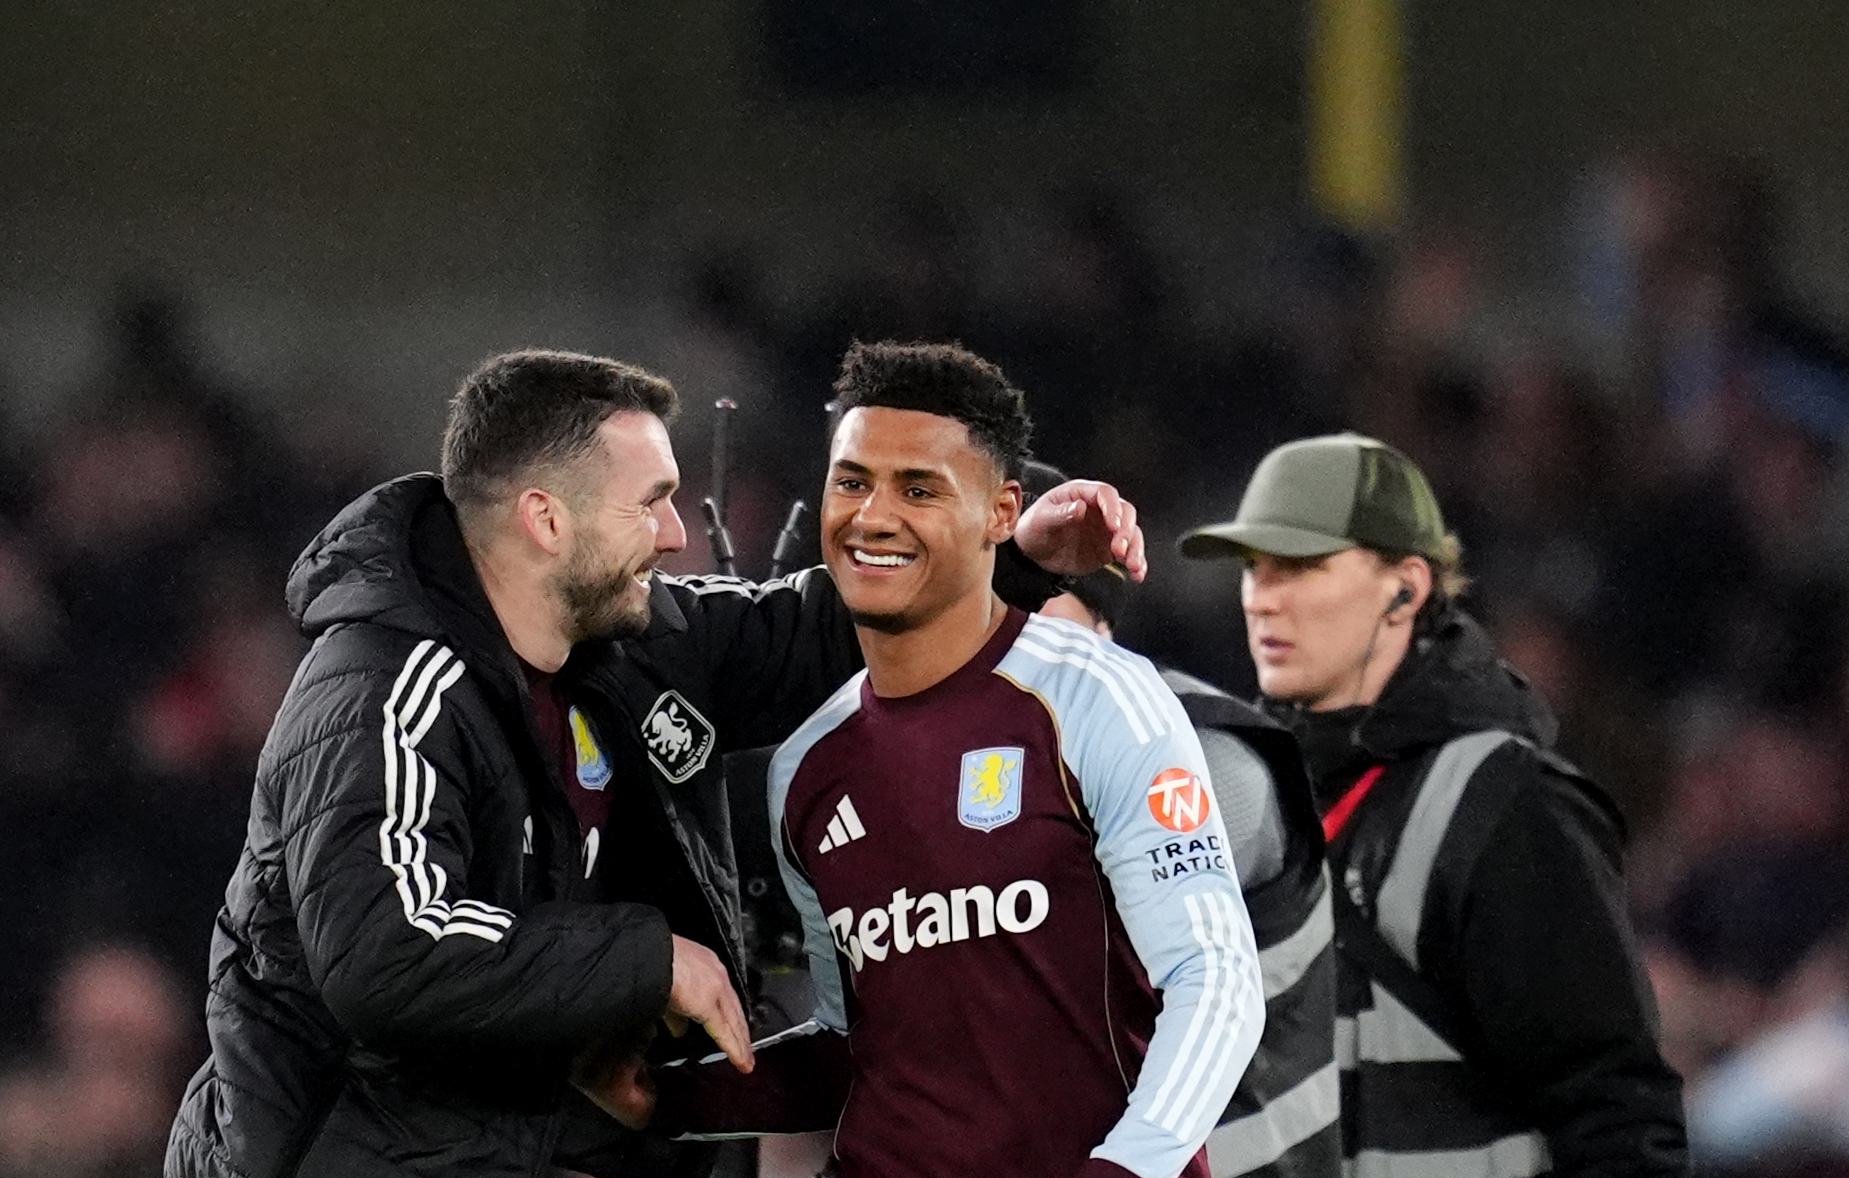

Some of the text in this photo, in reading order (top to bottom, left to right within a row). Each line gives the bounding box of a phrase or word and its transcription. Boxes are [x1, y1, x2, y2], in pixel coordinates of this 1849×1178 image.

[676, 755, 698, 777] ASTON
[695, 734, 709, 757] VILLA
[964, 809, 1014, 824] ASTON VILLA
[1145, 835, 1224, 864] TRAD
[827, 879, 1050, 973] Betano
